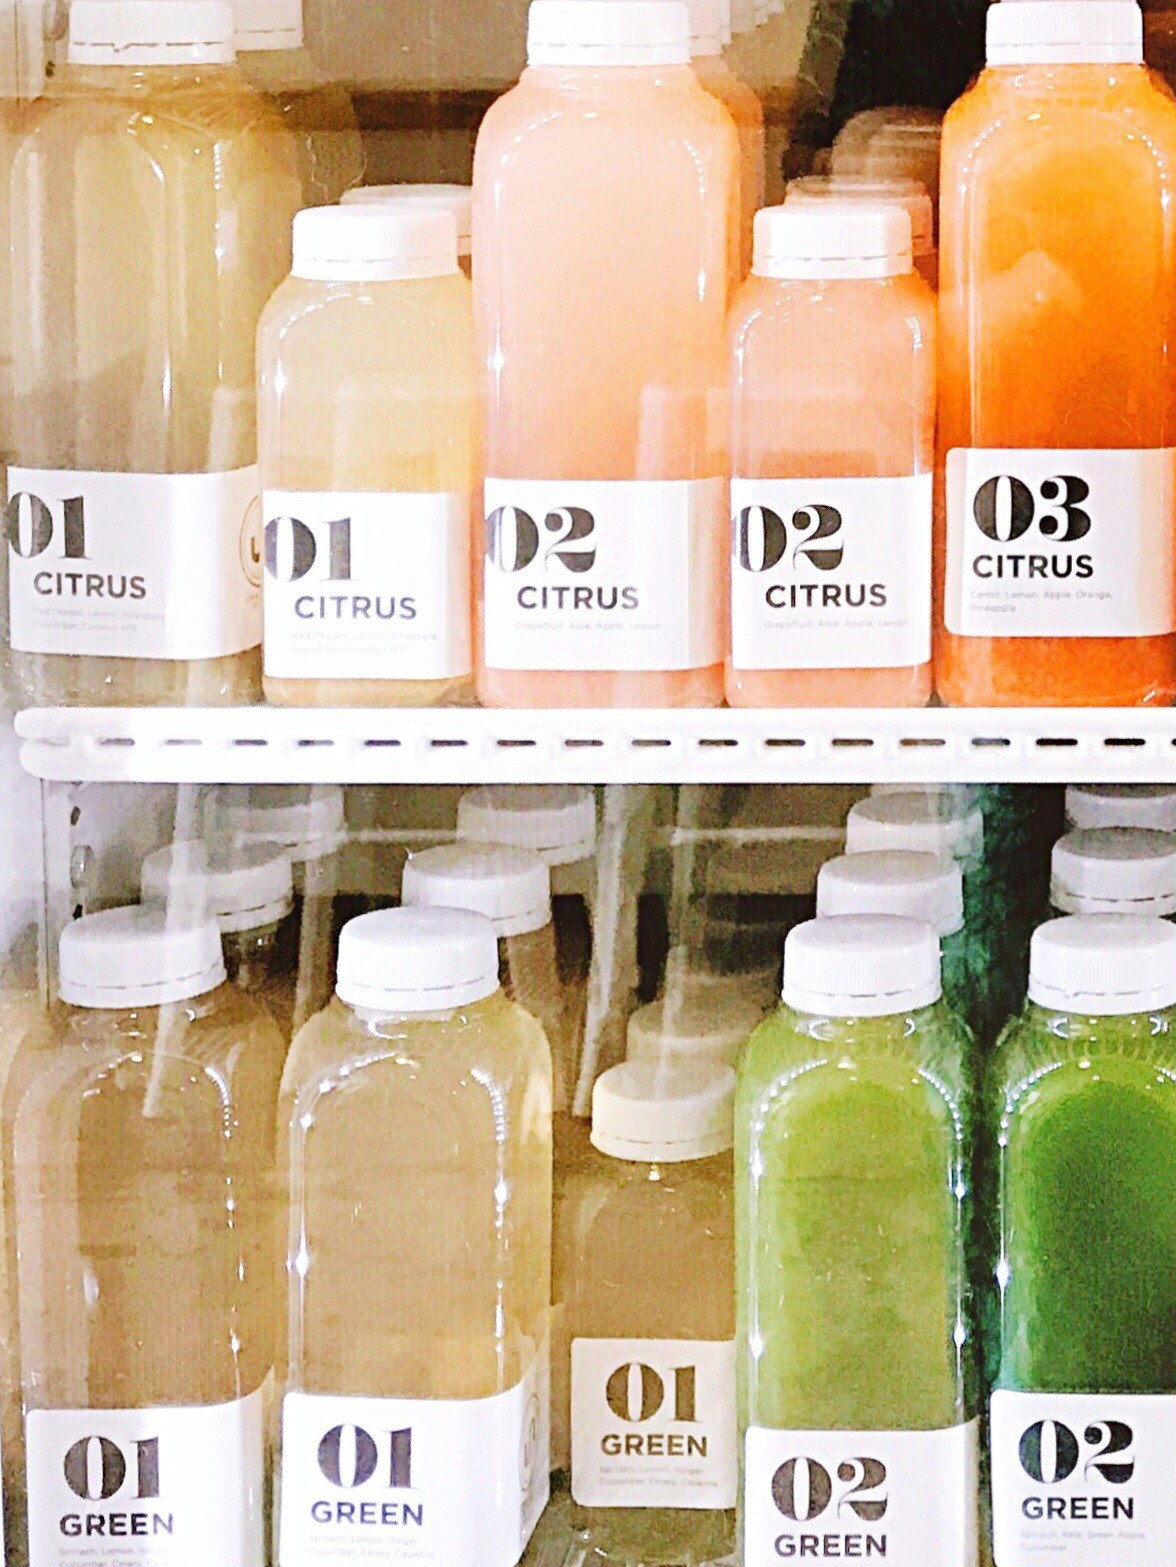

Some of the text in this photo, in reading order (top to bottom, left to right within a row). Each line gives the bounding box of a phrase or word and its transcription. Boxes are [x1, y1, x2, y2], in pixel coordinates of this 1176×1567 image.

[7, 491, 92, 560] 01
[973, 475, 1092, 542] 03
[264, 516, 360, 582] 01
[485, 505, 597, 573] 02
[731, 504, 844, 573] 02
[34, 572, 147, 600] CITRUS
[972, 555, 1094, 579] CITRUS
[294, 595, 417, 620] CITRUS
[517, 586, 639, 610] CITRUS
[765, 584, 887, 608] CITRUS
[606, 1362, 702, 1423] 01
[318, 1423, 419, 1489] 01
[601, 1433, 708, 1458] GREEN
[1019, 1419, 1135, 1484] 02
[64, 1435, 165, 1502] 01
[771, 1456, 888, 1522] 02
[59, 1513, 174, 1537] GREEN
[311, 1501, 424, 1527] GREEN
[1021, 1497, 1134, 1520] GREEN
[774, 1534, 887, 1558] GREEN
